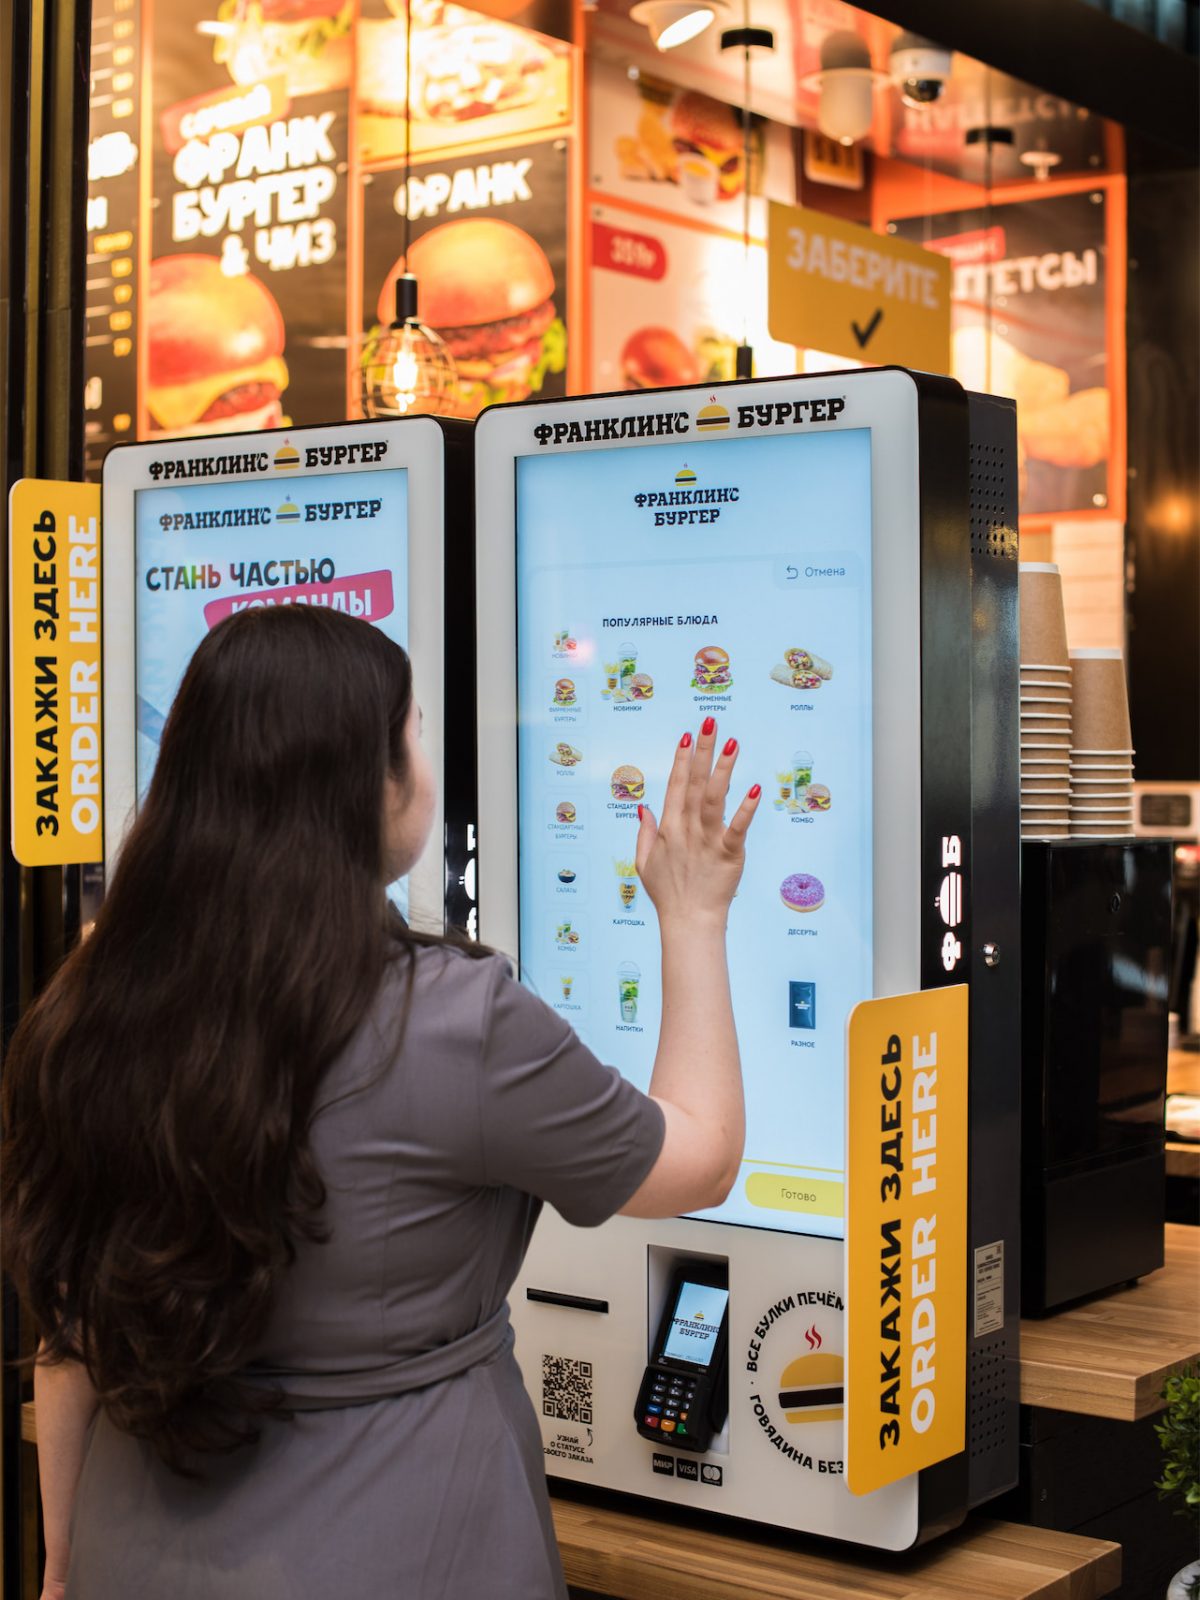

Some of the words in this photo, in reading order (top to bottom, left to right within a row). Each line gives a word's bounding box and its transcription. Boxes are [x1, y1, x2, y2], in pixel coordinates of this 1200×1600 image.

[173, 111, 337, 189] ФРАНК
[172, 165, 337, 242] БУРГЕР
[393, 158, 533, 221] ФРАНК
[255, 218, 337, 271] ЧИЗ
[786, 227, 940, 310] ЗАБЕРИТЕ
[737, 398, 845, 428] БУРГЕР
[305, 441, 388, 468] БУРГЕР
[305, 499, 382, 522] БУРГЕР
[654, 508, 720, 526] БУРГЕР
[33, 509, 59, 641] ЗДЕСЬ
[68, 515, 98, 643] HERE
[145, 563, 221, 592] СТАНЬ
[229, 557, 336, 587] ЧАСТЬЮ
[805, 566, 846, 578] Отмена
[602, 616, 674, 628] ПОПУЛЯРНЫЕ
[677, 615, 718, 626] БЛЮДА
[35, 656, 58, 837] ЗАКАЖИ
[69, 660, 99, 834] ORDER
[787, 928, 817, 936] ДЕСЕРТЫ
[791, 1040, 815, 1048] РАЗНОЕ
[880, 1032, 904, 1204] ЗДЕСЬ
[912, 1031, 938, 1197] HERE
[781, 1188, 817, 1202] Готово
[679, 1328, 710, 1340] БУРГЕР
[746, 1339, 762, 1372] ВСЕ
[754, 1295, 796, 1340] БУЛКИ
[879, 1217, 901, 1452] ЗАКАЖИ
[910, 1213, 937, 1435] ORDER
[556, 1434, 579, 1444] УЗНАЙ
[556, 1442, 585, 1454] СТАТУСЕ
[749, 1394, 813, 1470] ГОВЯДИНА
[567, 1452, 594, 1464] ЗАКАЗА
[678, 1463, 697, 1475] VISA
